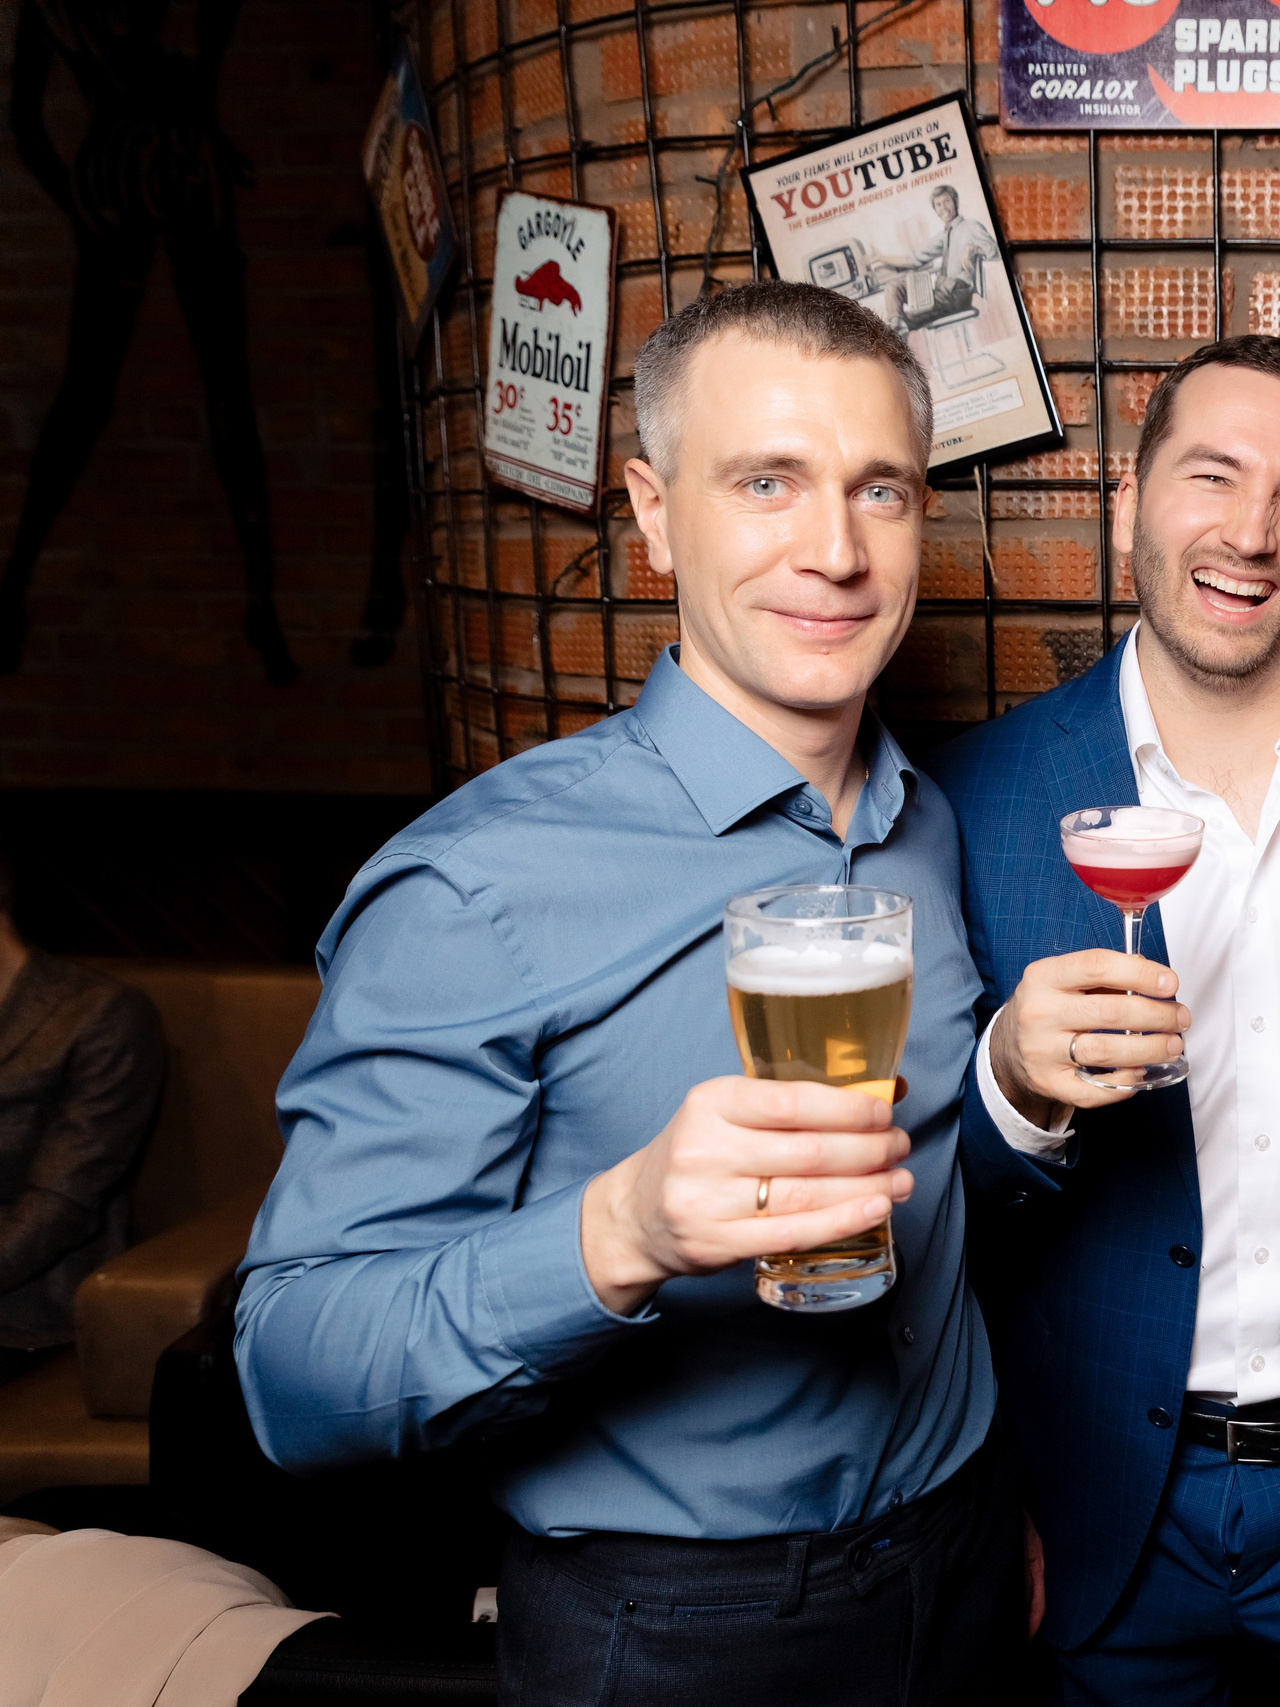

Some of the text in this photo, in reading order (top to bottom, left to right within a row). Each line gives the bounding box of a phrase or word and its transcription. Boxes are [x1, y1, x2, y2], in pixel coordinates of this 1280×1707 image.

[1028, 63, 1087, 76] PATENTED
[1029, 79, 1139, 100] CORALOX
[1080, 103, 1141, 117] INSULATOR
[770, 132, 957, 219] YOUTUBE
[777, 120, 940, 187] YOUR FILMS WILL LAST FOREVER ON
[788, 218, 803, 232] THE
[806, 202, 856, 226] CHAMPION
[858, 186, 893, 206] ADDRESS
[896, 182, 908, 193] ON
[517, 210, 585, 262] GARGOYLE
[499, 317, 591, 393] Mobiloil
[931, 436, 963, 452] UTUBE
